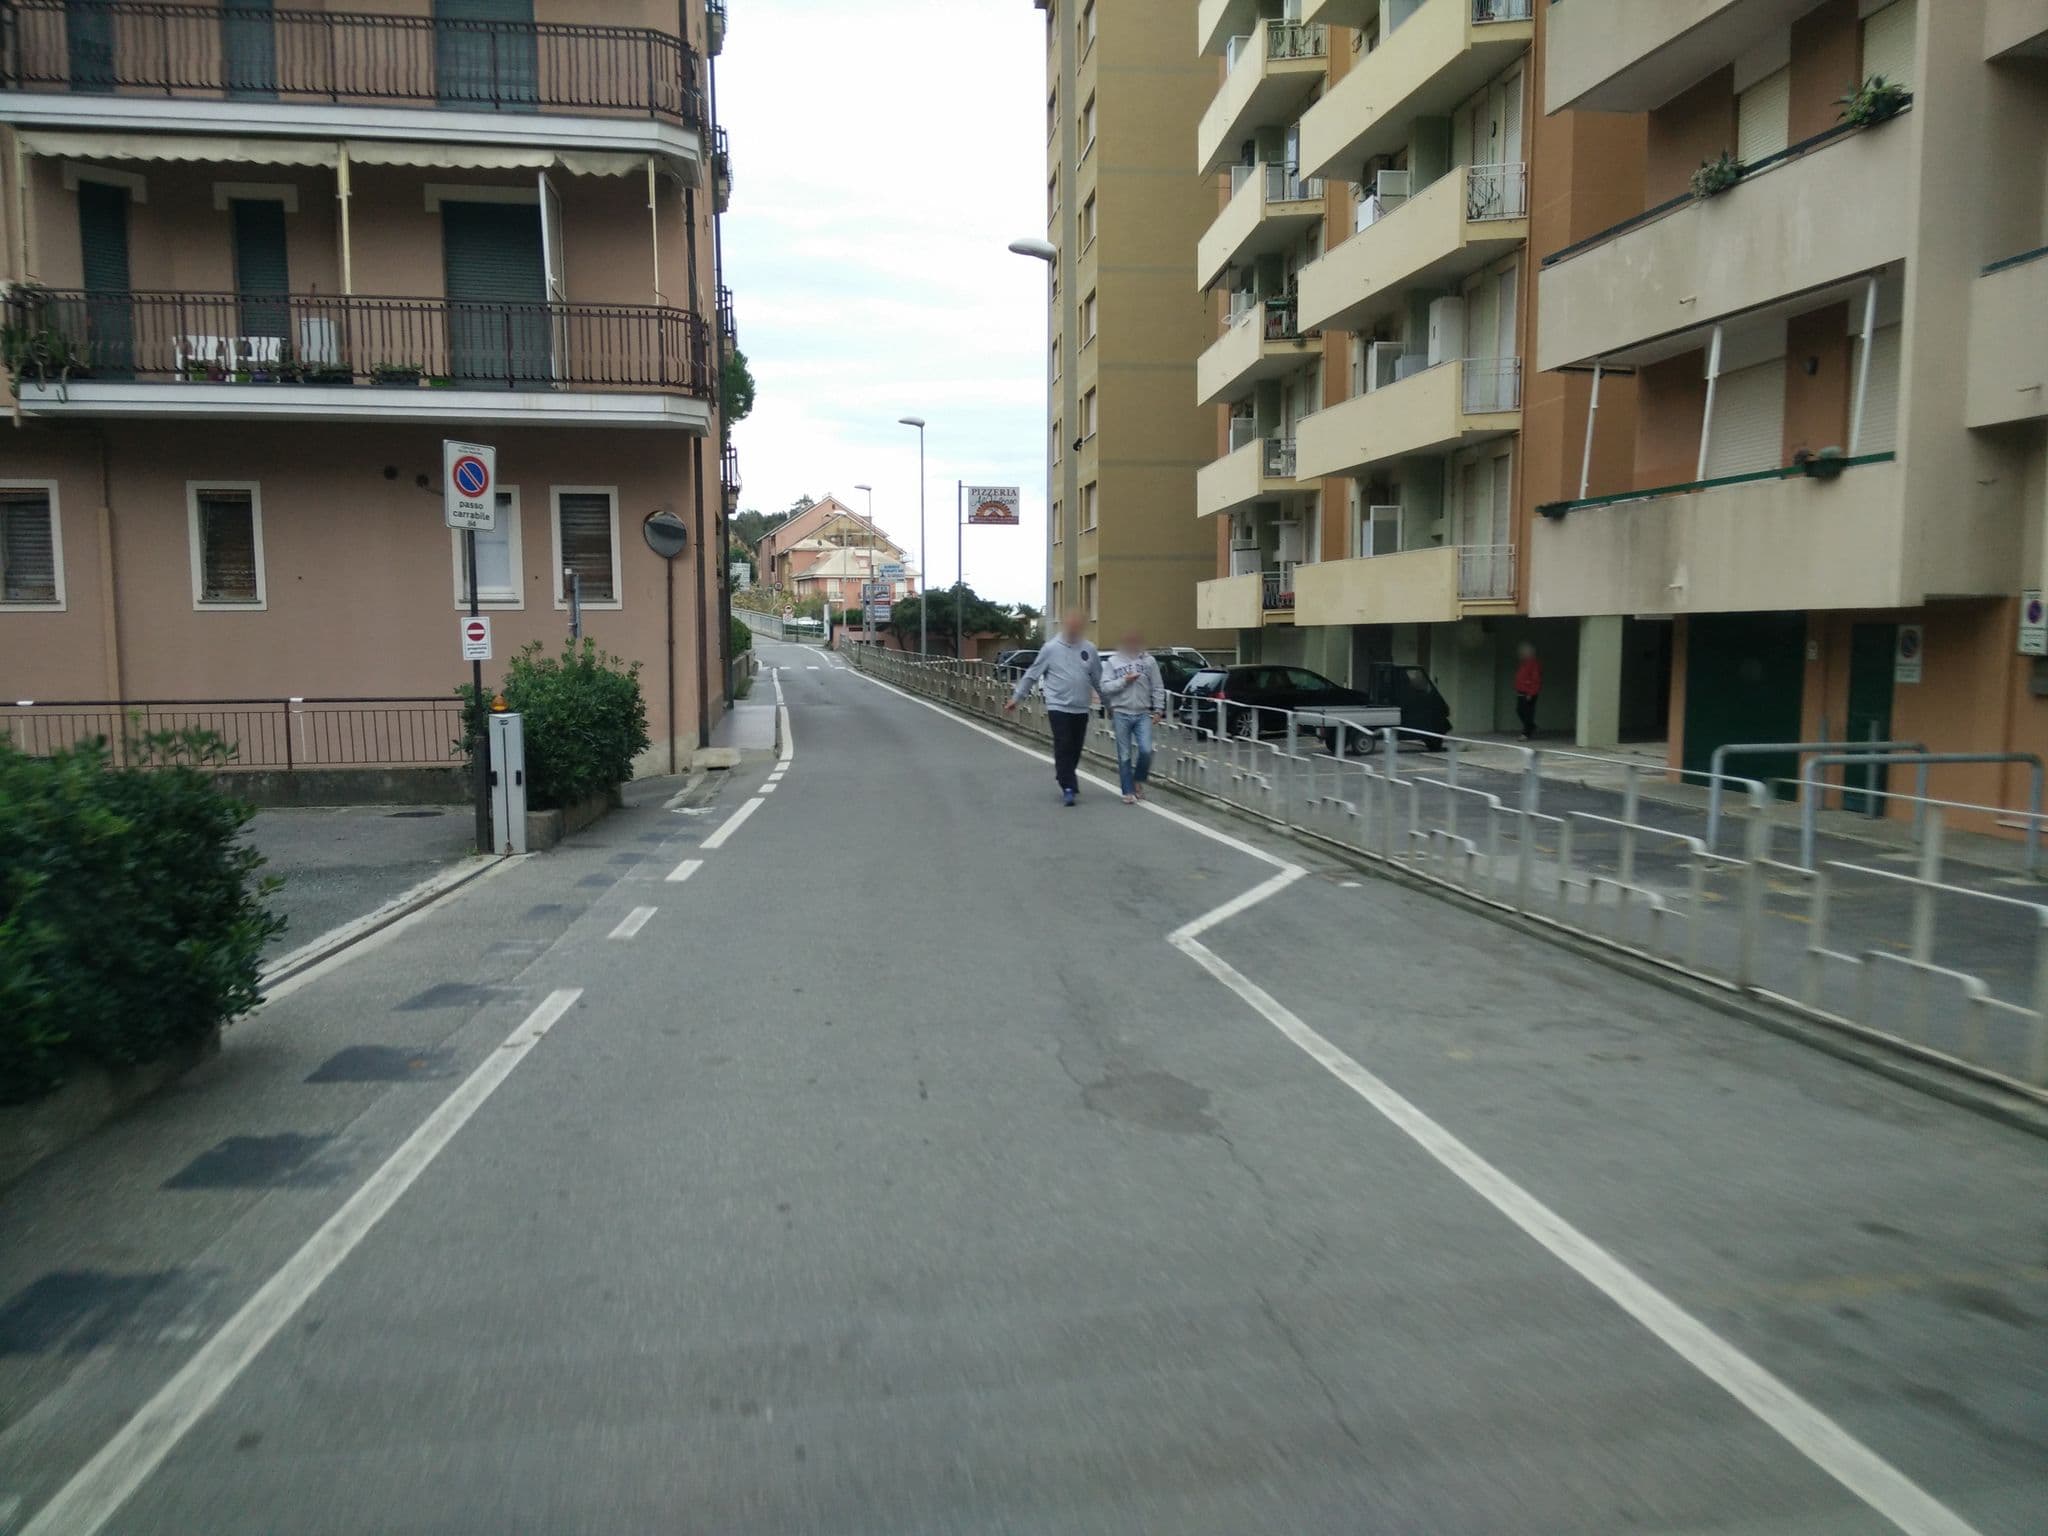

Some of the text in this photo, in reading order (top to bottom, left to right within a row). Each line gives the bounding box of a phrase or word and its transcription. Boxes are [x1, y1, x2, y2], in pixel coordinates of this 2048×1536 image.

[971, 488, 1017, 497] PIZZERIA
[459, 501, 484, 510] passo
[452, 510, 490, 521] carrabile
